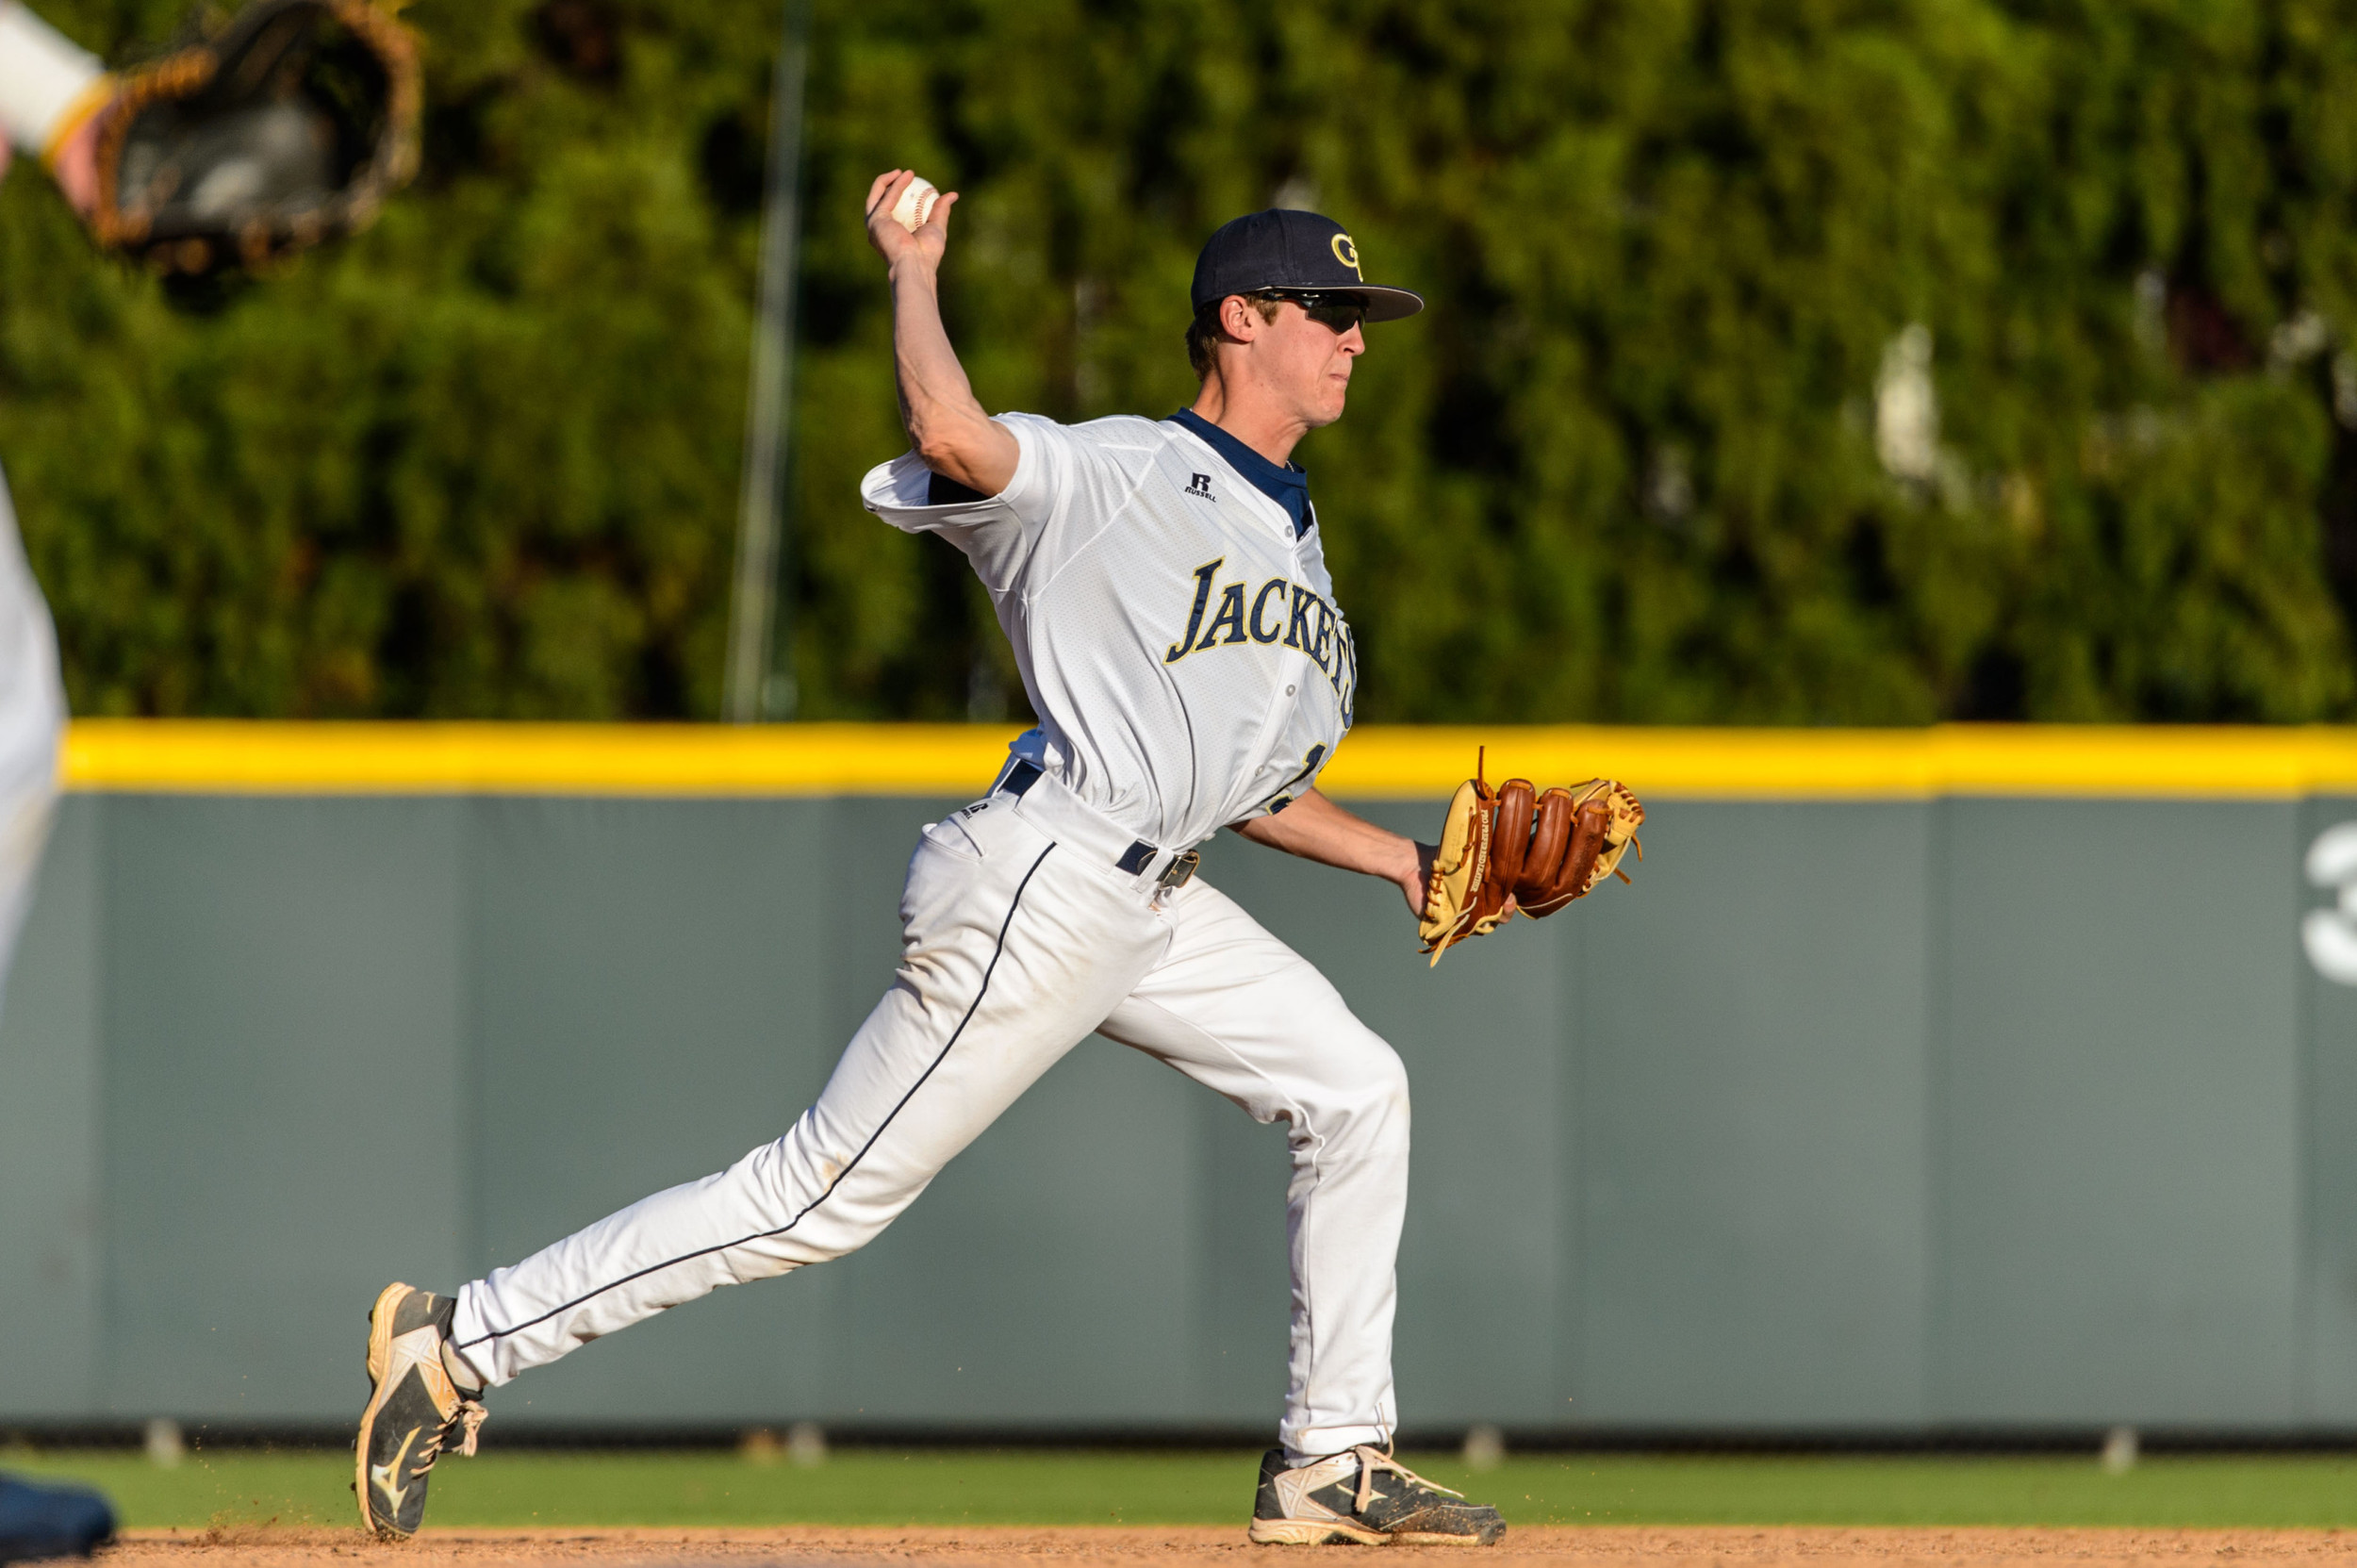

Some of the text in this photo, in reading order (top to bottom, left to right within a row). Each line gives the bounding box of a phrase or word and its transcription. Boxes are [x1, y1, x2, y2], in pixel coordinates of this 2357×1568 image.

[1192, 472, 1211, 491] R
[1184, 486, 1216, 503] RUSSELL
[1480, 809, 1489, 823] PRO
